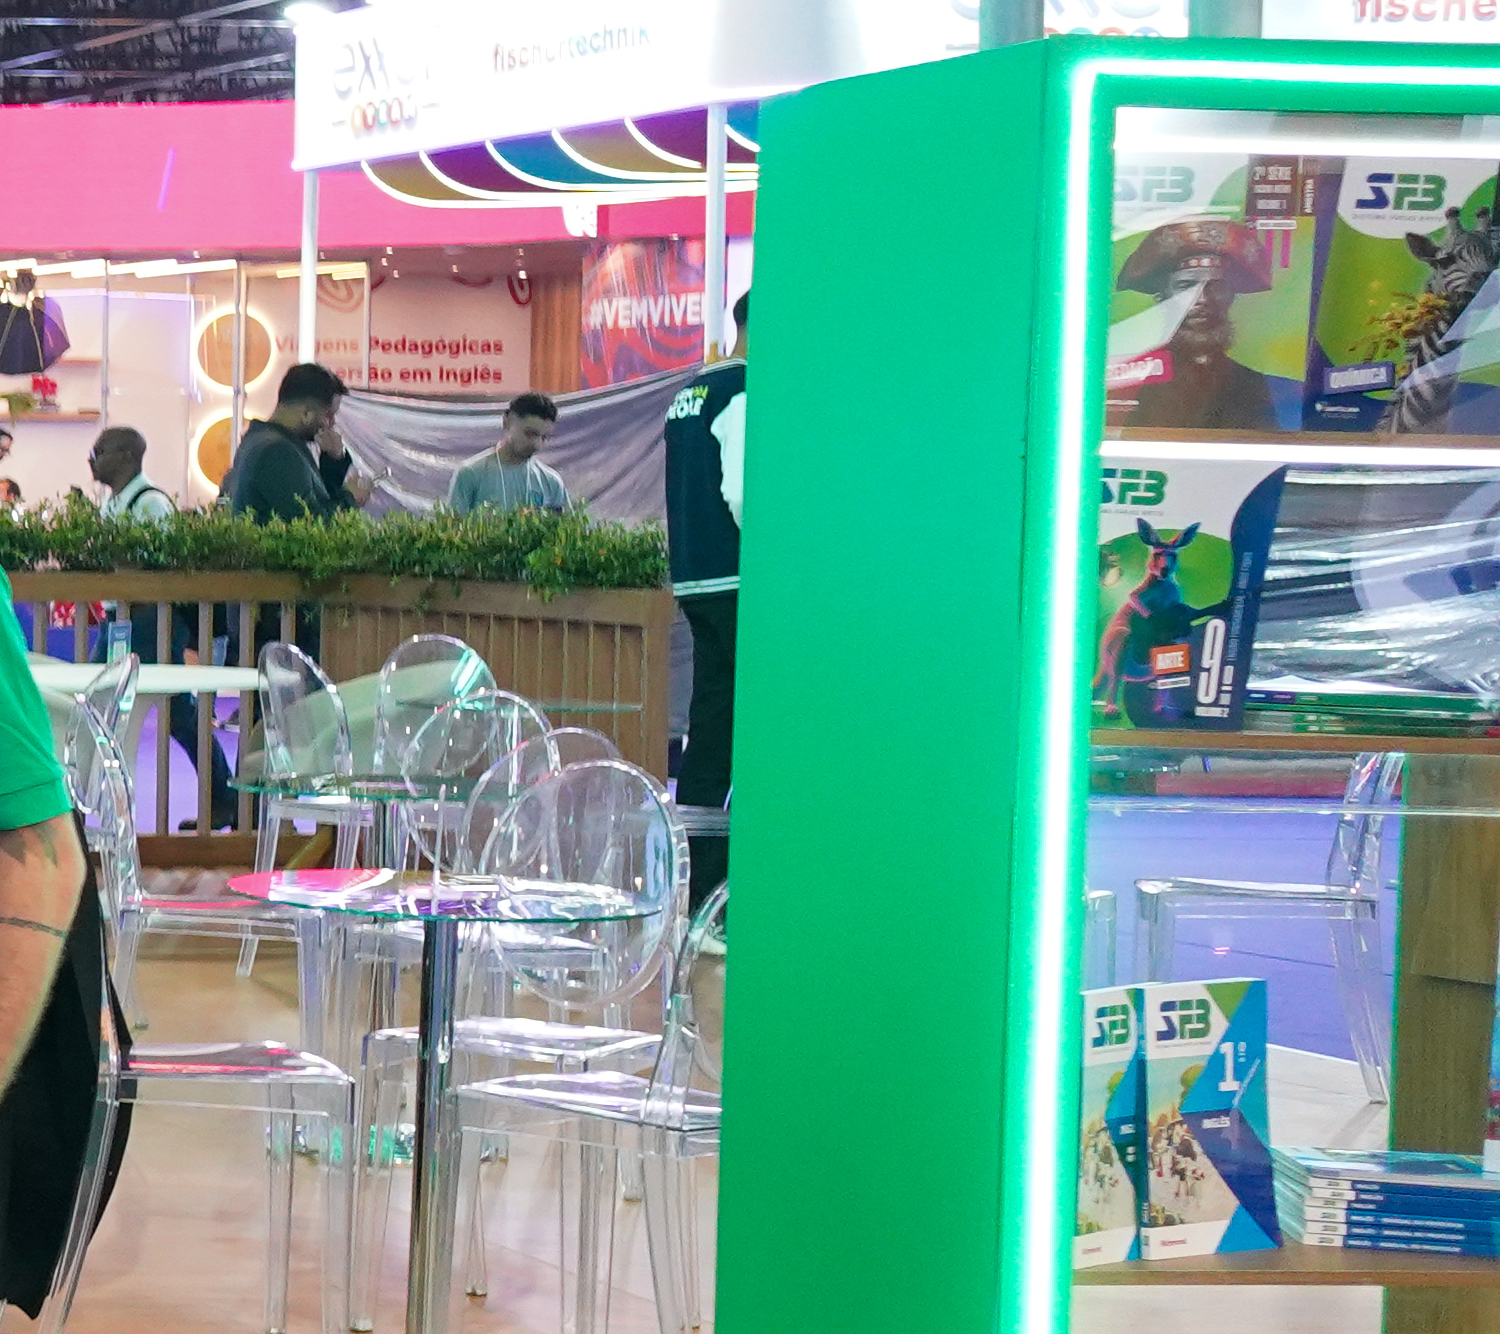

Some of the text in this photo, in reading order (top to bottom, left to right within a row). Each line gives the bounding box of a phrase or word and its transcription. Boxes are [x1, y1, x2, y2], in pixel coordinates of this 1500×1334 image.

[1356, 173, 1446, 210] SFB
[590, 292, 705, 329] #VEMVIVE
[400, 364, 502, 385] em Inglês
[1156, 652, 1184, 670] ARTE
[1156, 998, 1211, 1041] SFB
